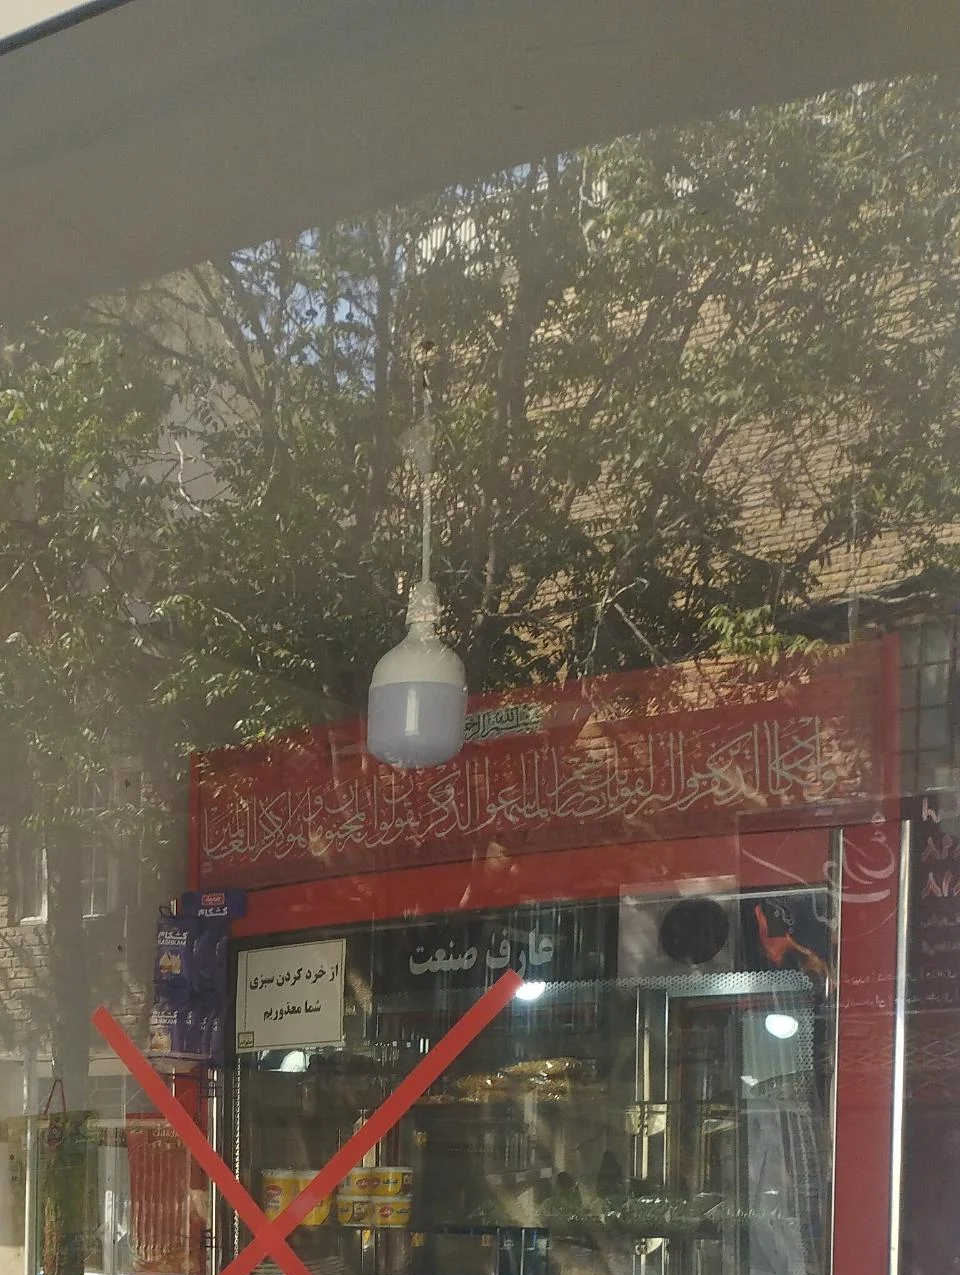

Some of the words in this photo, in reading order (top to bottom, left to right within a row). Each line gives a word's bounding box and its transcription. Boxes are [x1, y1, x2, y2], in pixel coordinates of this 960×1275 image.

[408, 939, 478, 976] صنعت
[276, 966, 304, 988] کردن
[306, 965, 327, 985] خرد
[329, 963, 340, 982] از
[248, 974, 275, 991] سبزی
[262, 1003, 303, 1022] معذوریم
[303, 999, 322, 1014] شما
